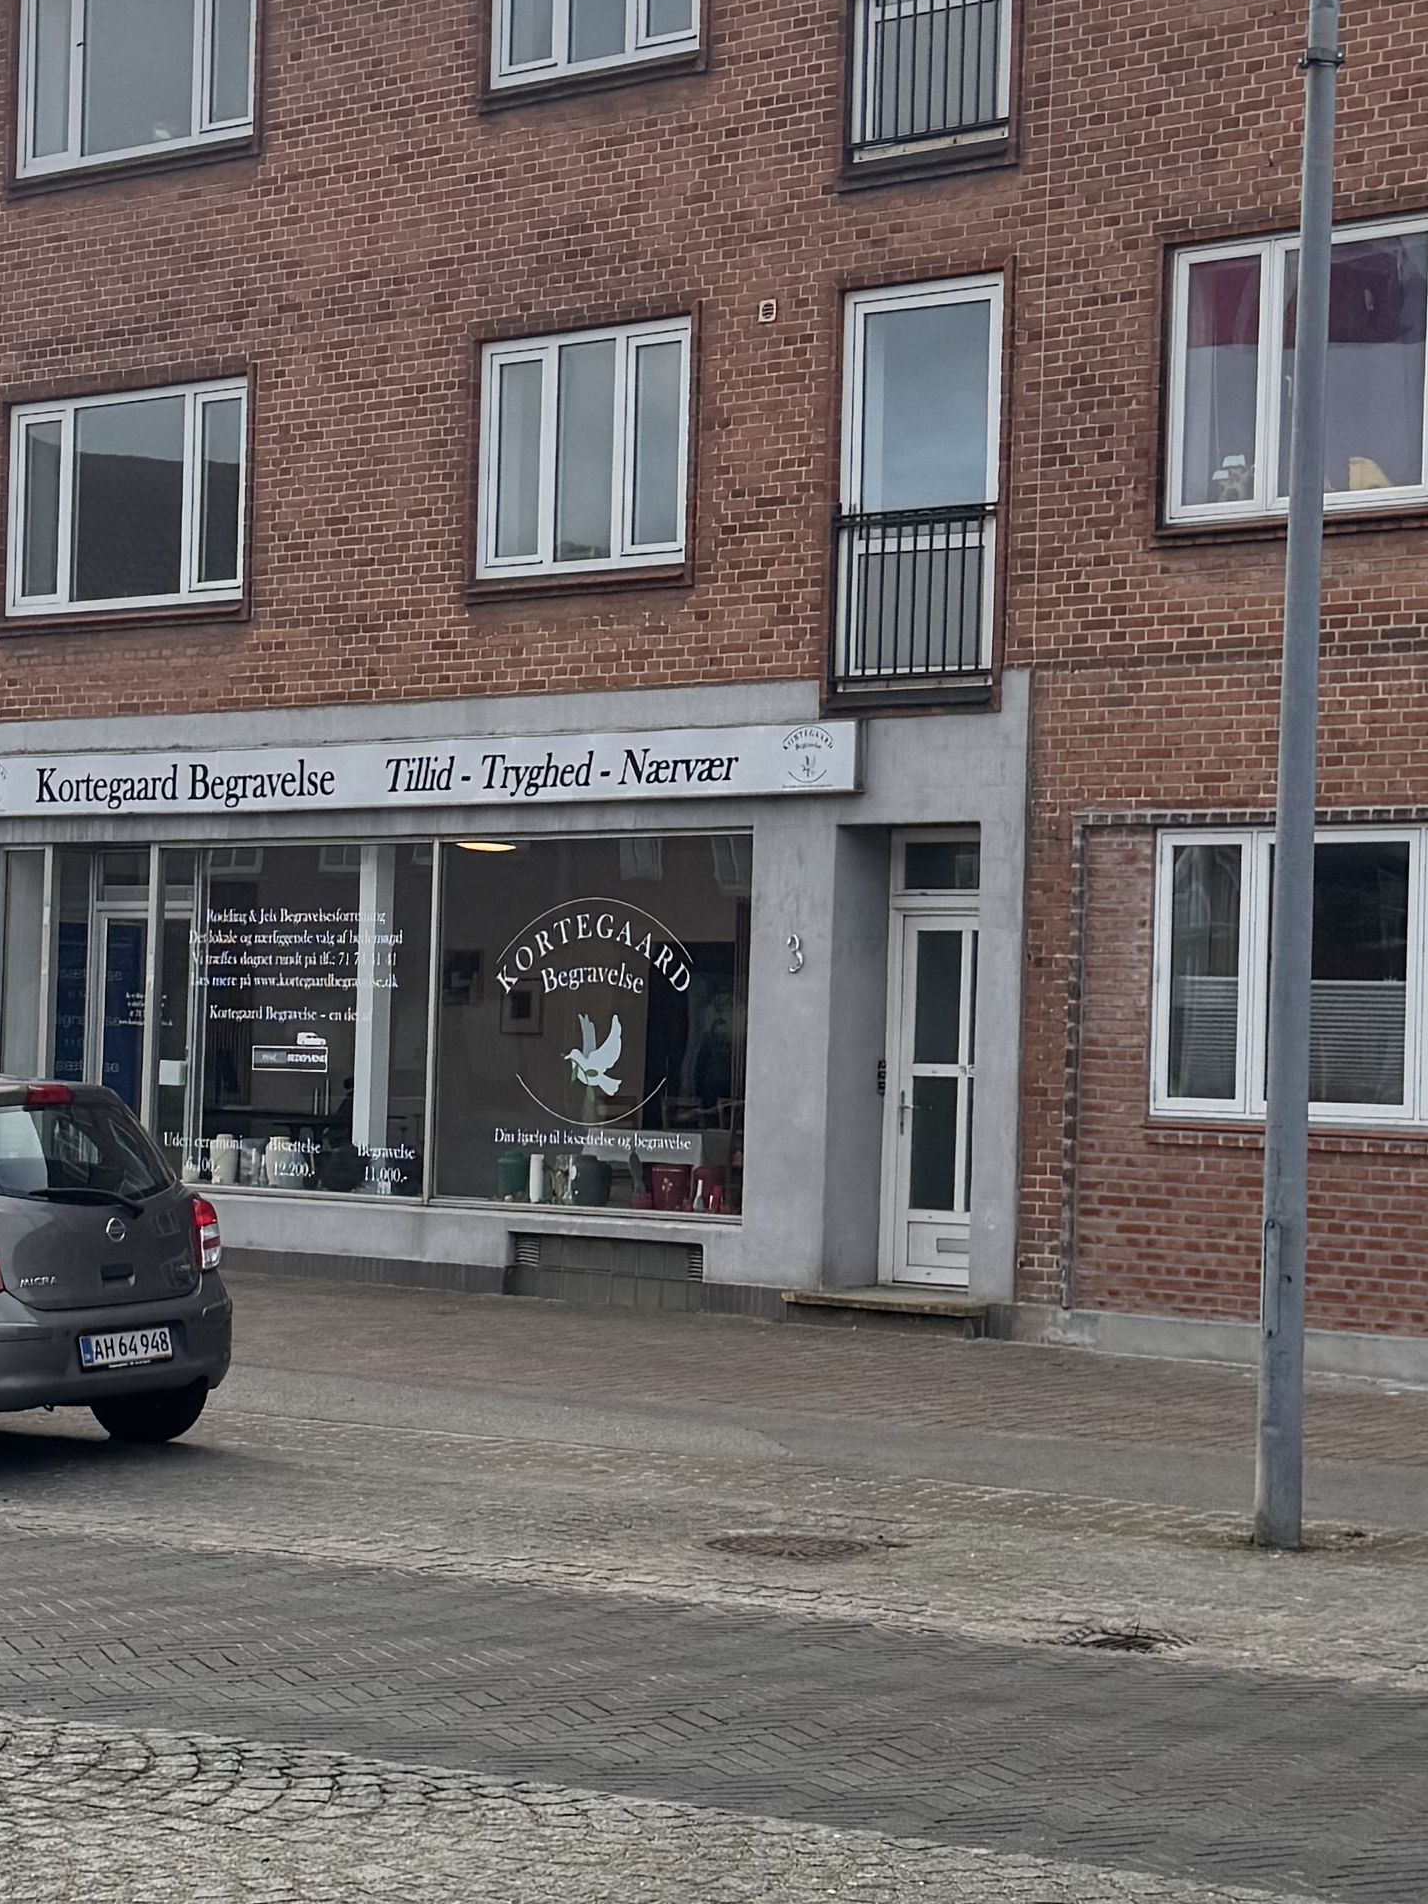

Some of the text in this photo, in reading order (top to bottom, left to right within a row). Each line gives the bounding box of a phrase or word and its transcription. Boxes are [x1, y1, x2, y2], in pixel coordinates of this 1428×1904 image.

[35, 764, 178, 809] Kortegaard
[188, 759, 335, 808] Begravelse
[386, 755, 454, 792] Tillid
[481, 750, 595, 797] Tryghed
[618, 749, 739, 784] Nærvær
[280, 908, 386, 925] Begravelsesforrening
[209, 929, 238, 944] lokale
[240, 934, 252, 946] og
[316, 929, 335, 947] valg
[337, 929, 348, 944] af
[496, 913, 691, 994] KORTEGAARD
[787, 933, 805, 974] 3
[212, 976, 237, 986] mere
[239, 972, 252, 990] på
[541, 963, 644, 994] Begravelse
[209, 1004, 263, 1021] Kortegaard
[266, 1004, 317, 1022] Begravelse
[329, 1010, 342, 1021] en
[494, 1127, 515, 1144] Din
[518, 1128, 547, 1148] hjælp
[549, 1129, 561, 1144] til
[618, 1135, 631, 1149] og
[634, 1132, 691, 1151] begravelse
[357, 1143, 416, 1161] Begravelse
[94, 1330, 170, 1360] AH 64 948
